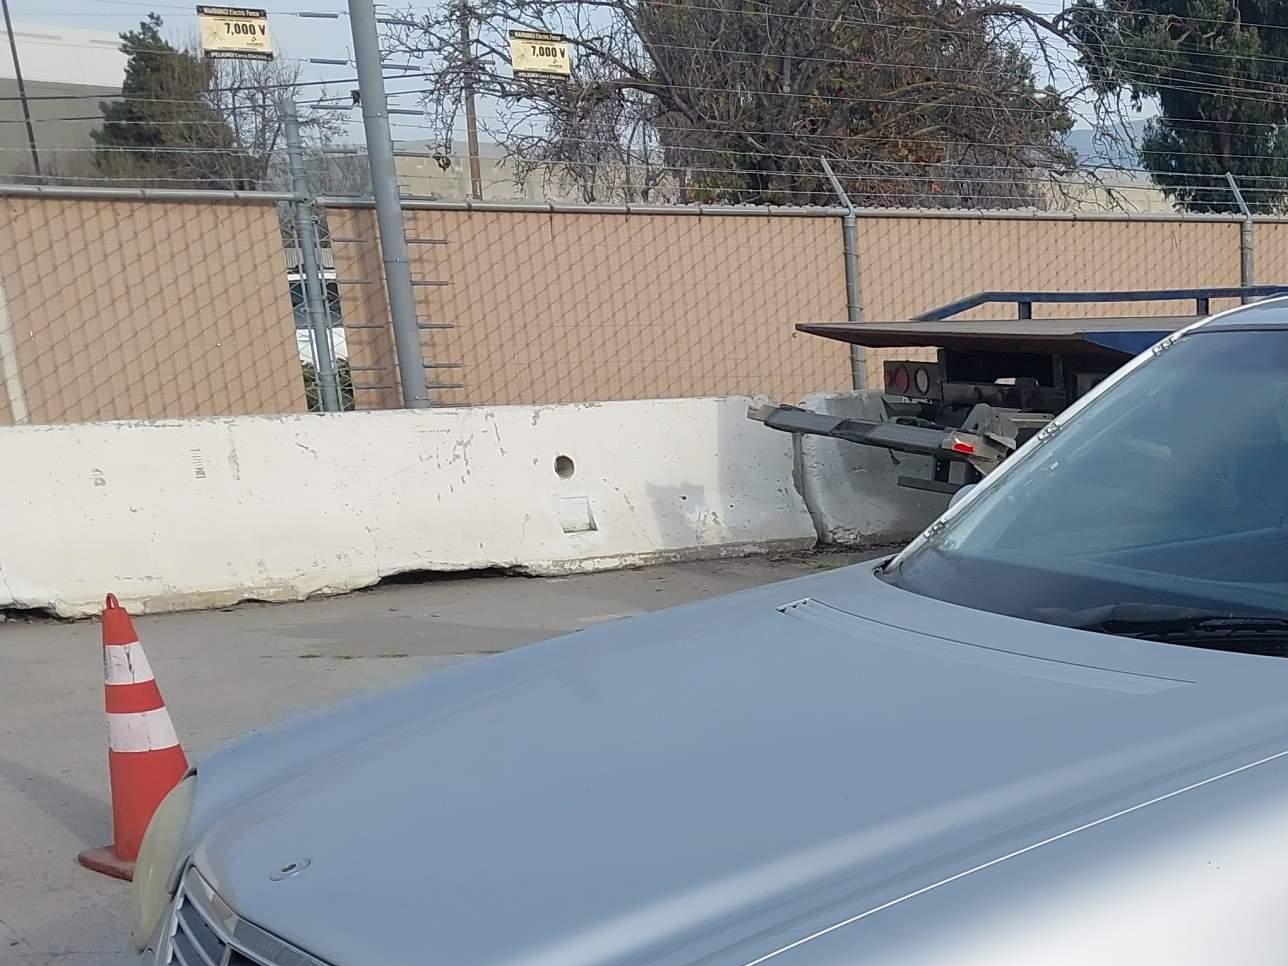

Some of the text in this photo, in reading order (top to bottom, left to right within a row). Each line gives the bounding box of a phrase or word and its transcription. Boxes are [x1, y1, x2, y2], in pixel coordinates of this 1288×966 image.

[224, 22, 266, 36] 7,000 V
[530, 45, 566, 59] 7,000 V
